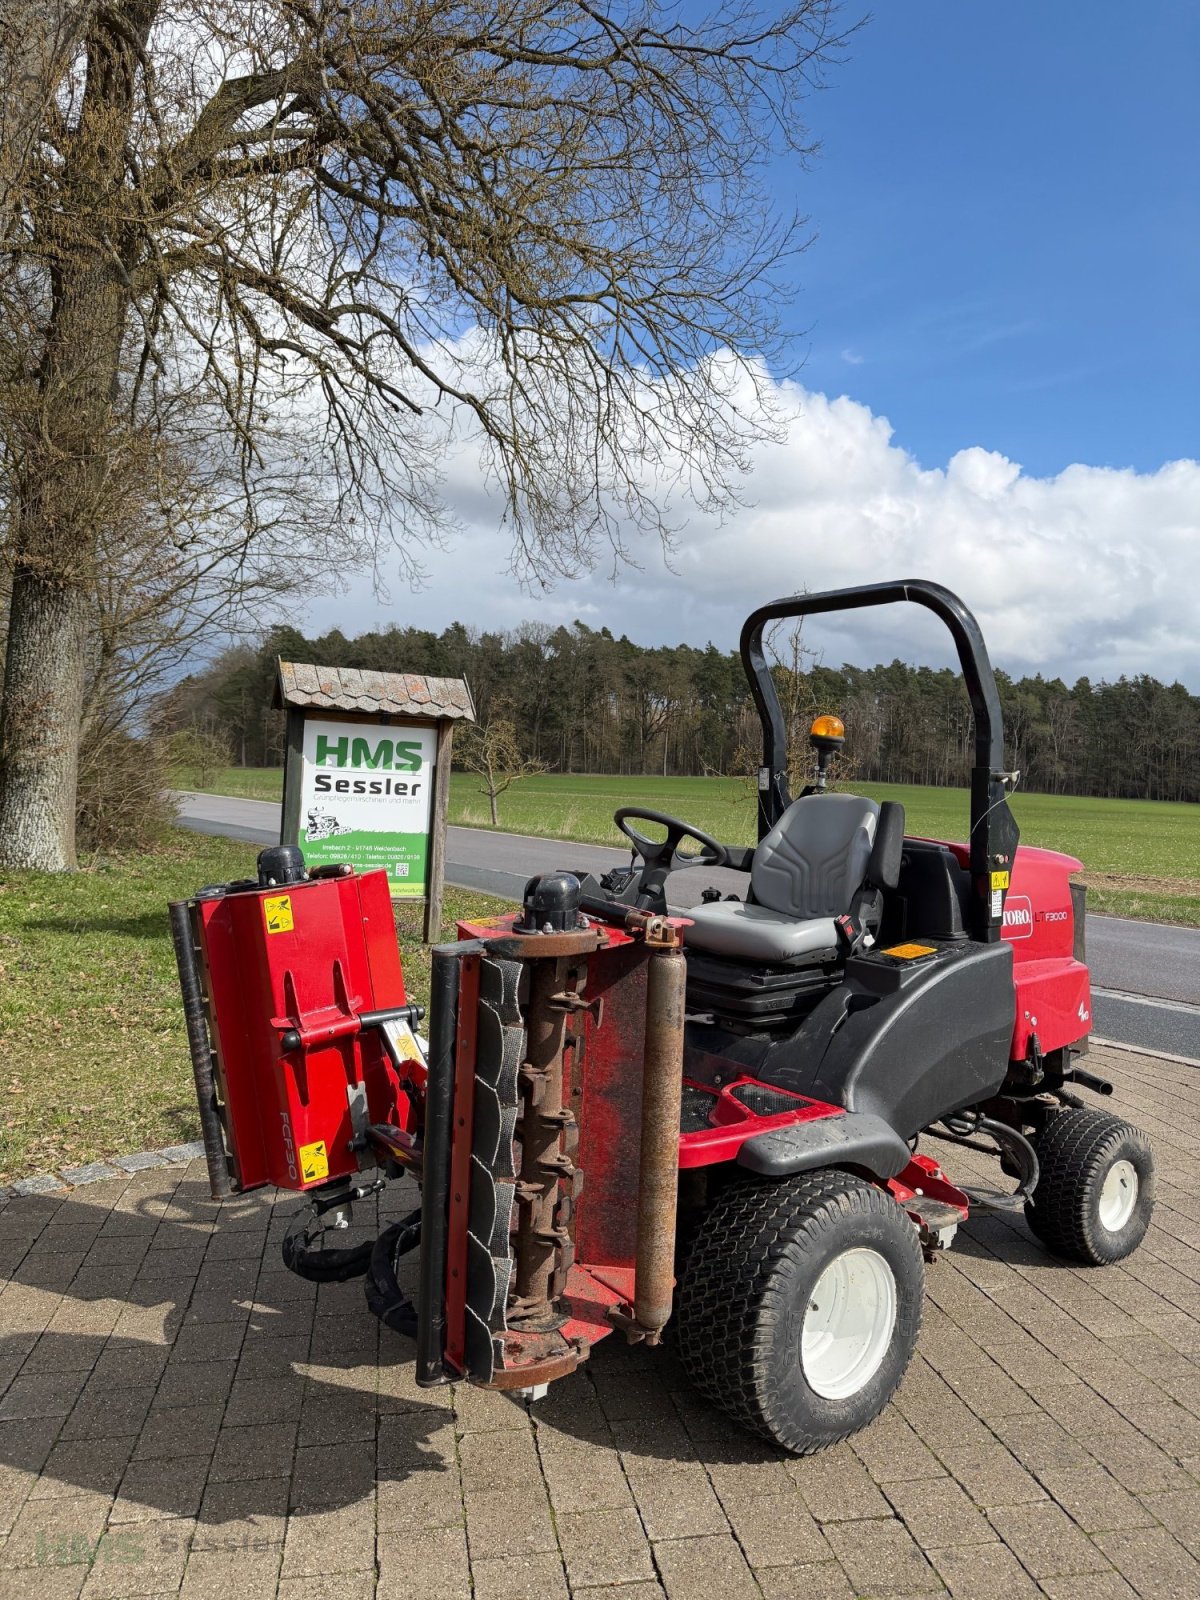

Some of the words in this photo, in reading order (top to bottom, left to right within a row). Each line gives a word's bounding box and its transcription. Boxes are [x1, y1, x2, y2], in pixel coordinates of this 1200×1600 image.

[316, 735, 422, 772] HMS
[314, 774, 421, 796] Sessler
[280, 1112, 298, 1180] FCF30
